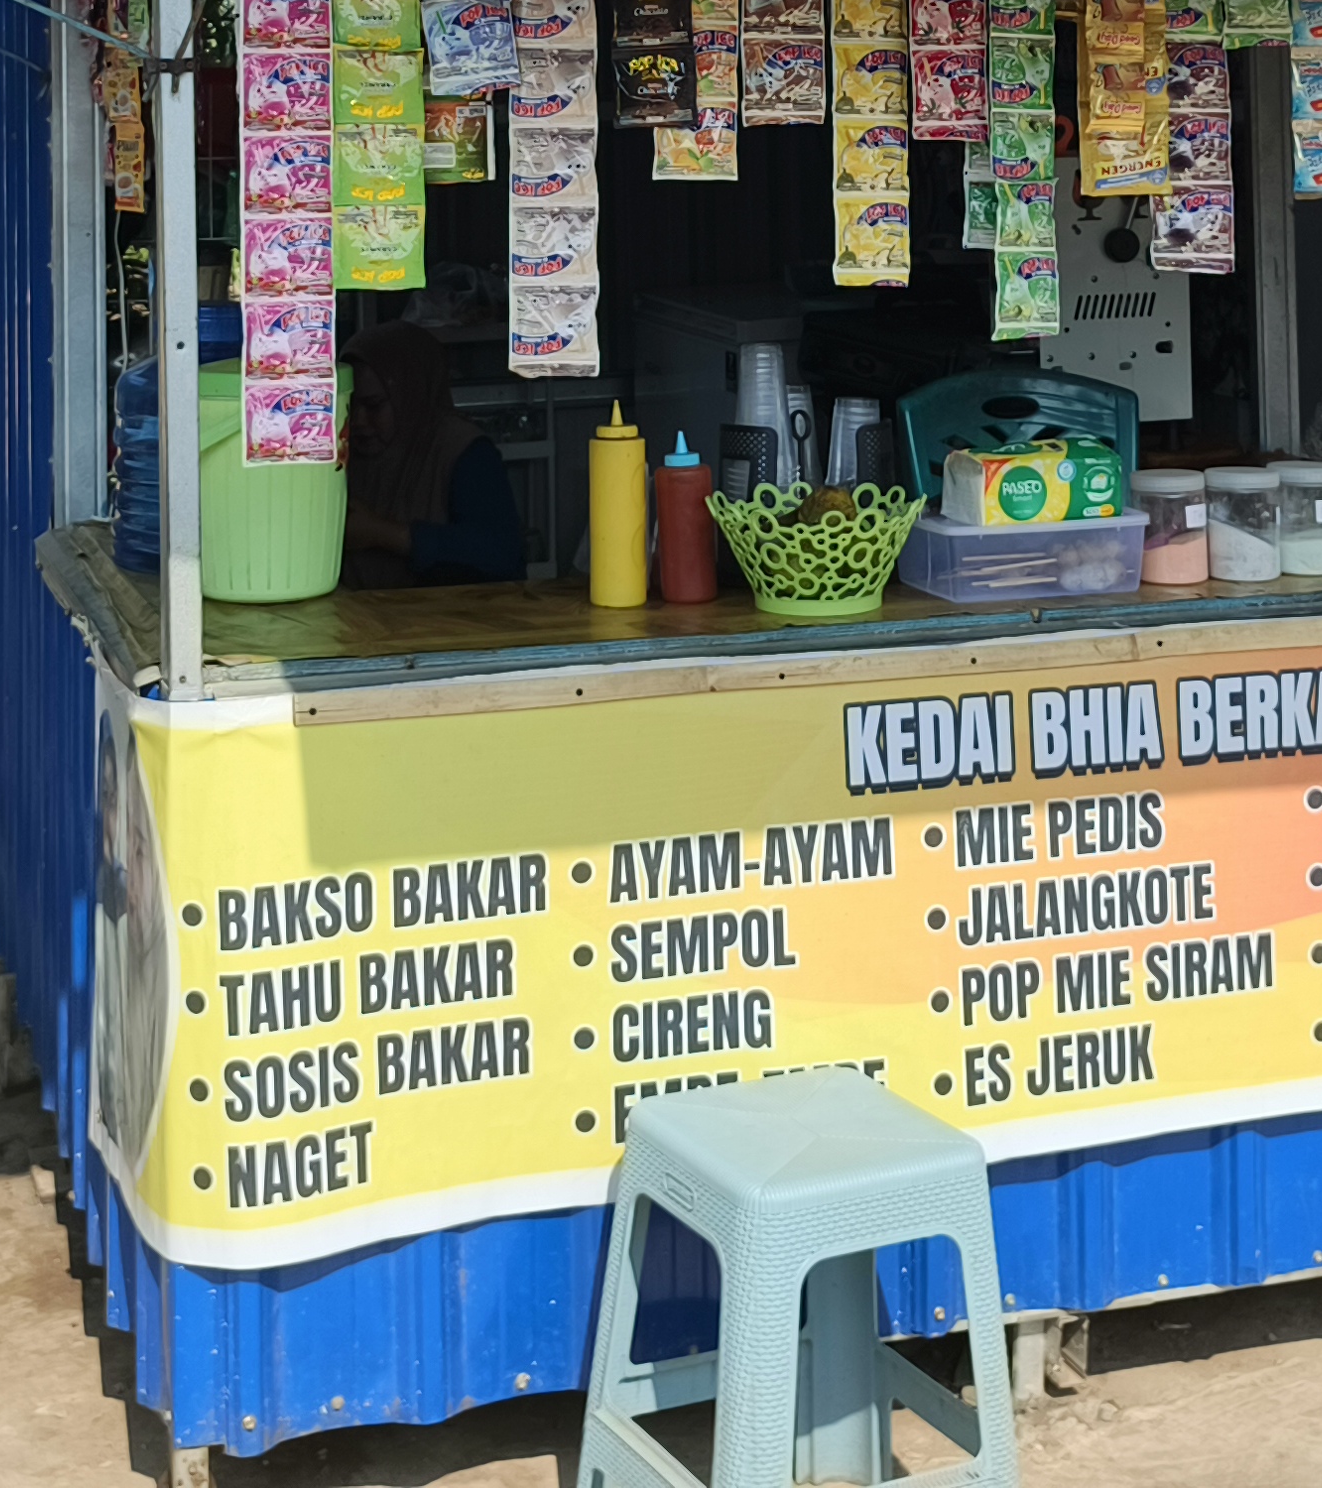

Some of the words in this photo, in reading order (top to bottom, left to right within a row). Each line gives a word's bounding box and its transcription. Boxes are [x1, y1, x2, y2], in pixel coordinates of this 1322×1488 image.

[1101, 159, 1162, 176] ENERGEN
[1002, 479, 1043, 496] PASEO
[845, 690, 1014, 796] KEDAI
[1029, 679, 1165, 778] BHIA
[610, 817, 893, 902] AYAM-AYAM
[956, 803, 1033, 868] MIE
[1047, 792, 1163, 859] PEDIS
[218, 871, 374, 951] BAKSO
[392, 853, 546, 928] BAKAR
[957, 862, 1215, 945] JALANGKOTE
[611, 908, 796, 982] SEMPOL
[961, 960, 1040, 1026] POP
[1055, 949, 1132, 1013] MIE
[1146, 932, 1273, 1002] SIRAM
[219, 959, 341, 1037] TAHU
[359, 938, 513, 1014] BAKAR
[612, 989, 772, 1062] CIRENG
[224, 1041, 360, 1122] SOSIS
[378, 1017, 530, 1095] BAKAR
[964, 1043, 1011, 1106] ES
[1027, 1023, 1154, 1097] JERUK
[227, 1120, 374, 1208] NAGET
